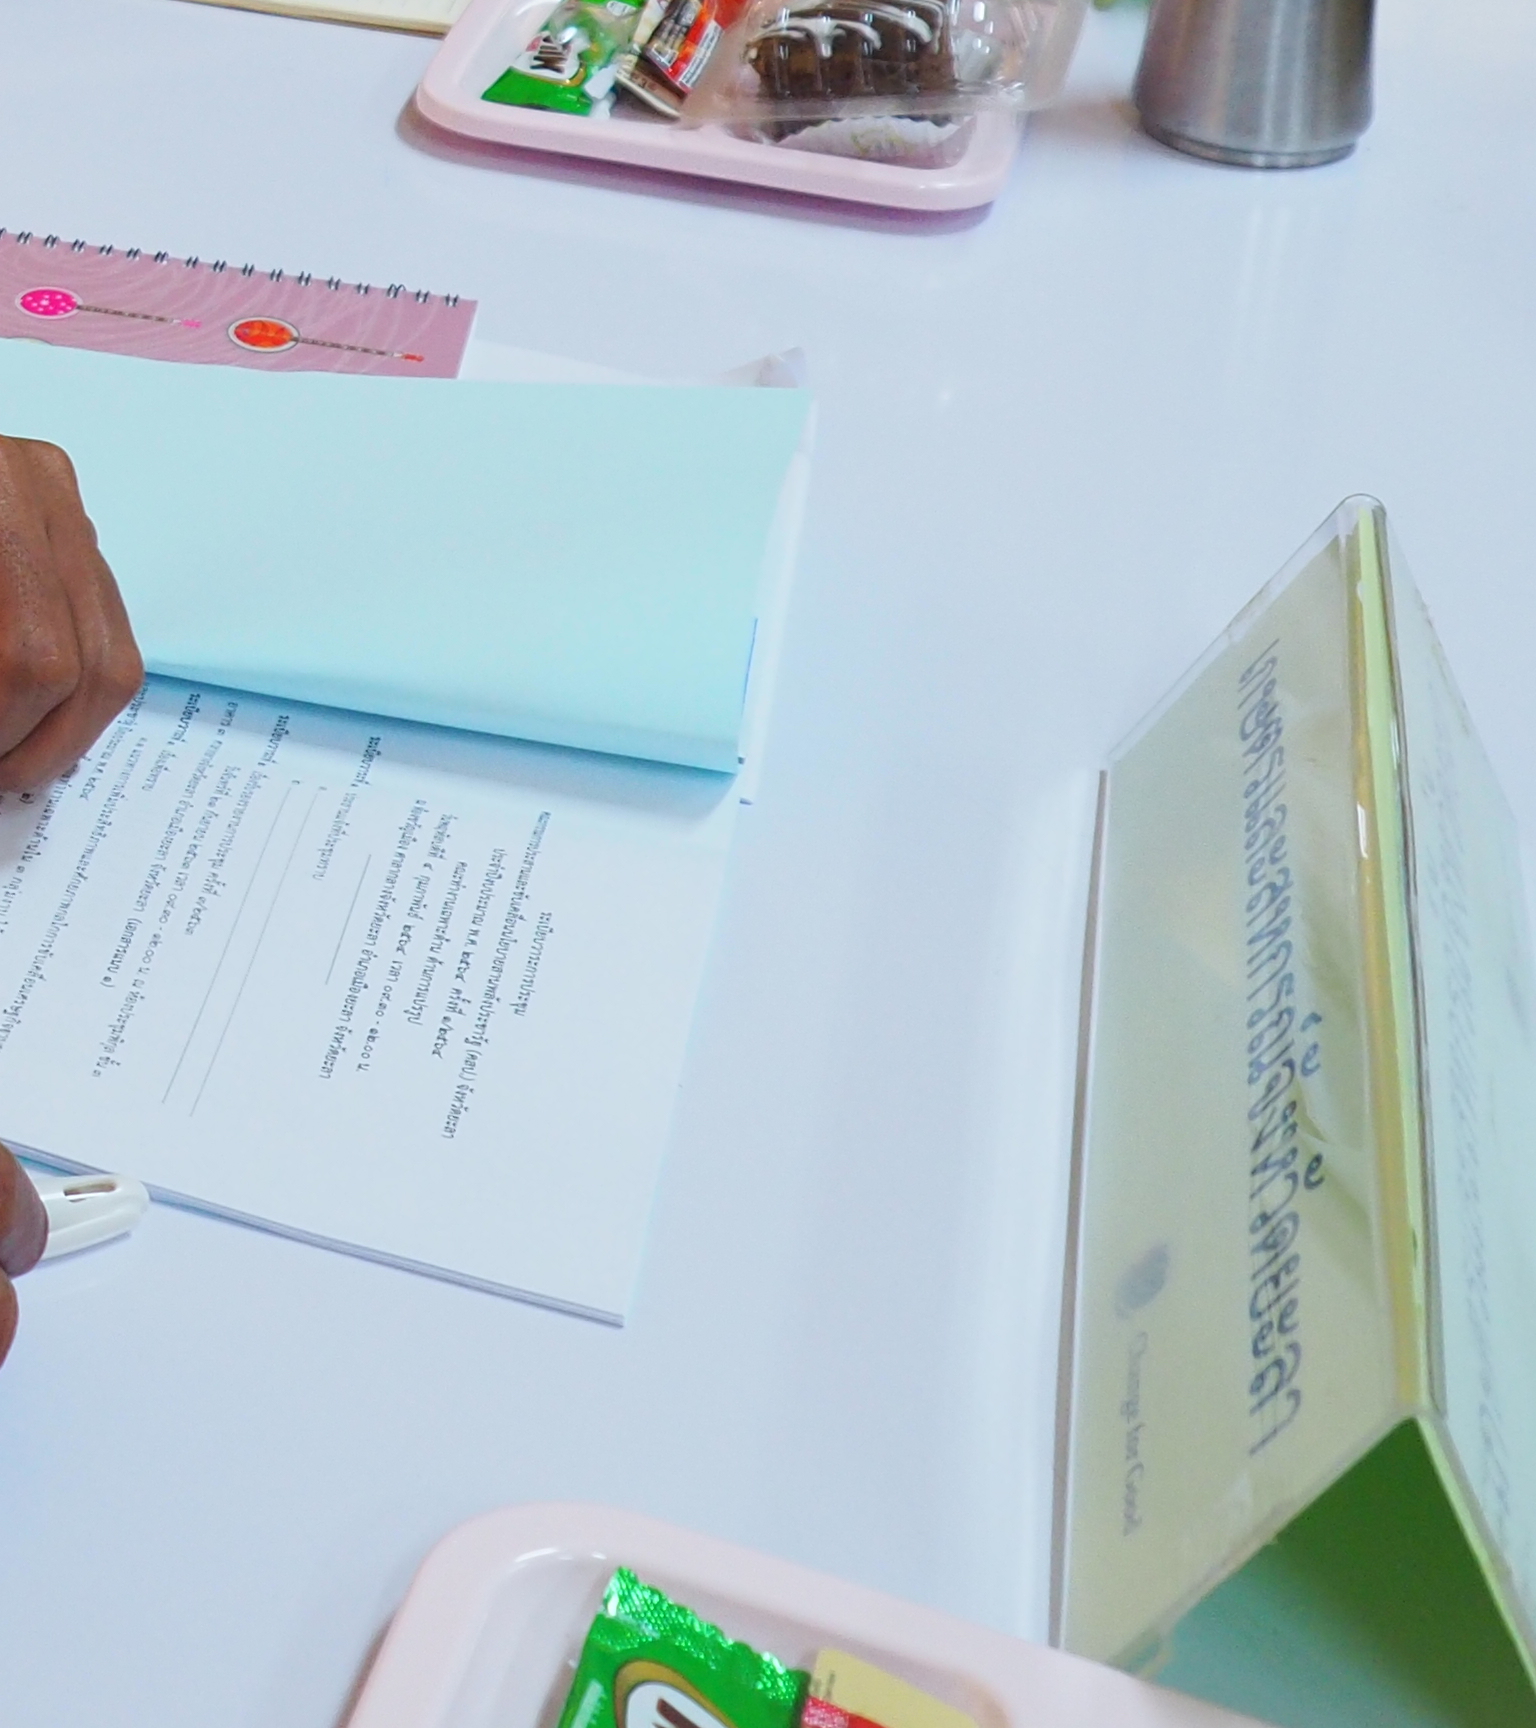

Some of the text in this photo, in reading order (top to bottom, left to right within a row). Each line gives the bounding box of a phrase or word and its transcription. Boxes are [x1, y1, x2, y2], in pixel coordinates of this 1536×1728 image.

[402, 872, 435, 922] กุมภาพันธ์
[429, 861, 468, 954] คณะทำงานเฉพาะด้าน
[339, 948, 378, 1023] อำเภอเมืองยะลา
[445, 987, 472, 1017] ครั้งที่
[319, 1025, 353, 1080] จังหวัดยะลา
[1237, 639, 1324, 1457] เกษตรและสหกรณ์จังหวัดยะลา
[442, 1083, 475, 1139] จังหวัดยะลา
